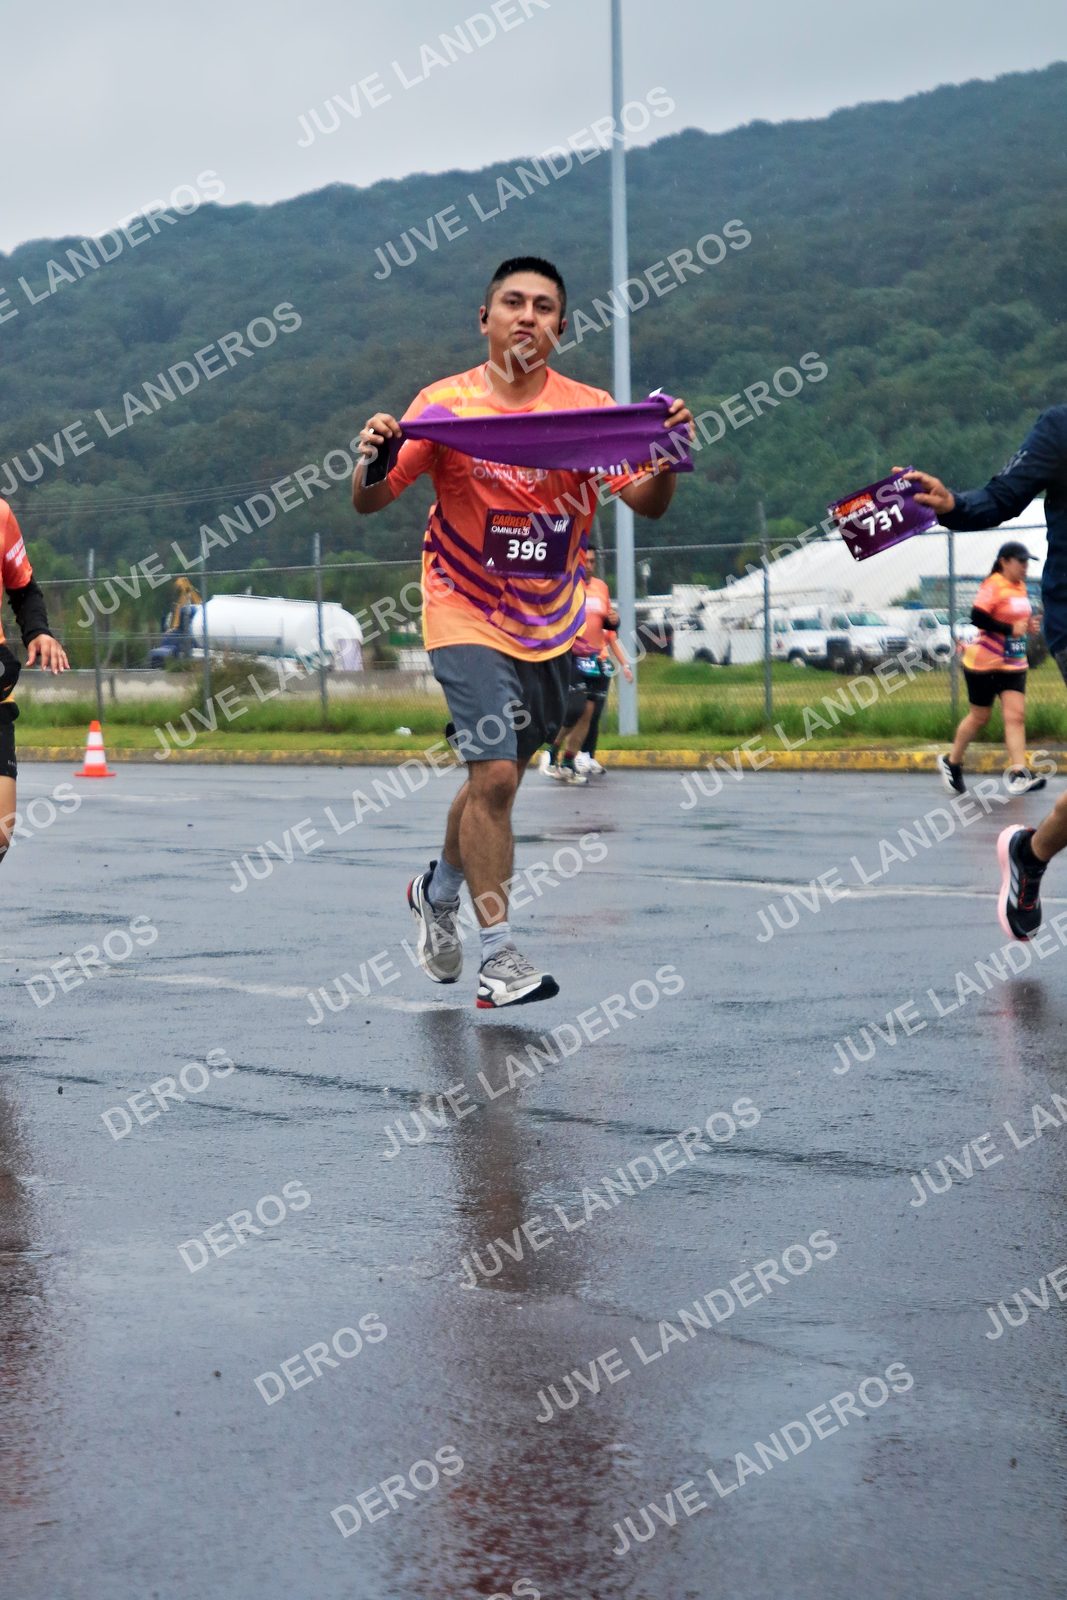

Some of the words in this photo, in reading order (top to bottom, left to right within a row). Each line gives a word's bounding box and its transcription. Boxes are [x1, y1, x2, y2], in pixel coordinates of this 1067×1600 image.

[491, 514, 532, 527] CARRERA
[554, 519, 569, 533] 16K
[862, 503, 904, 536] 731
[506, 539, 548, 561] 396
